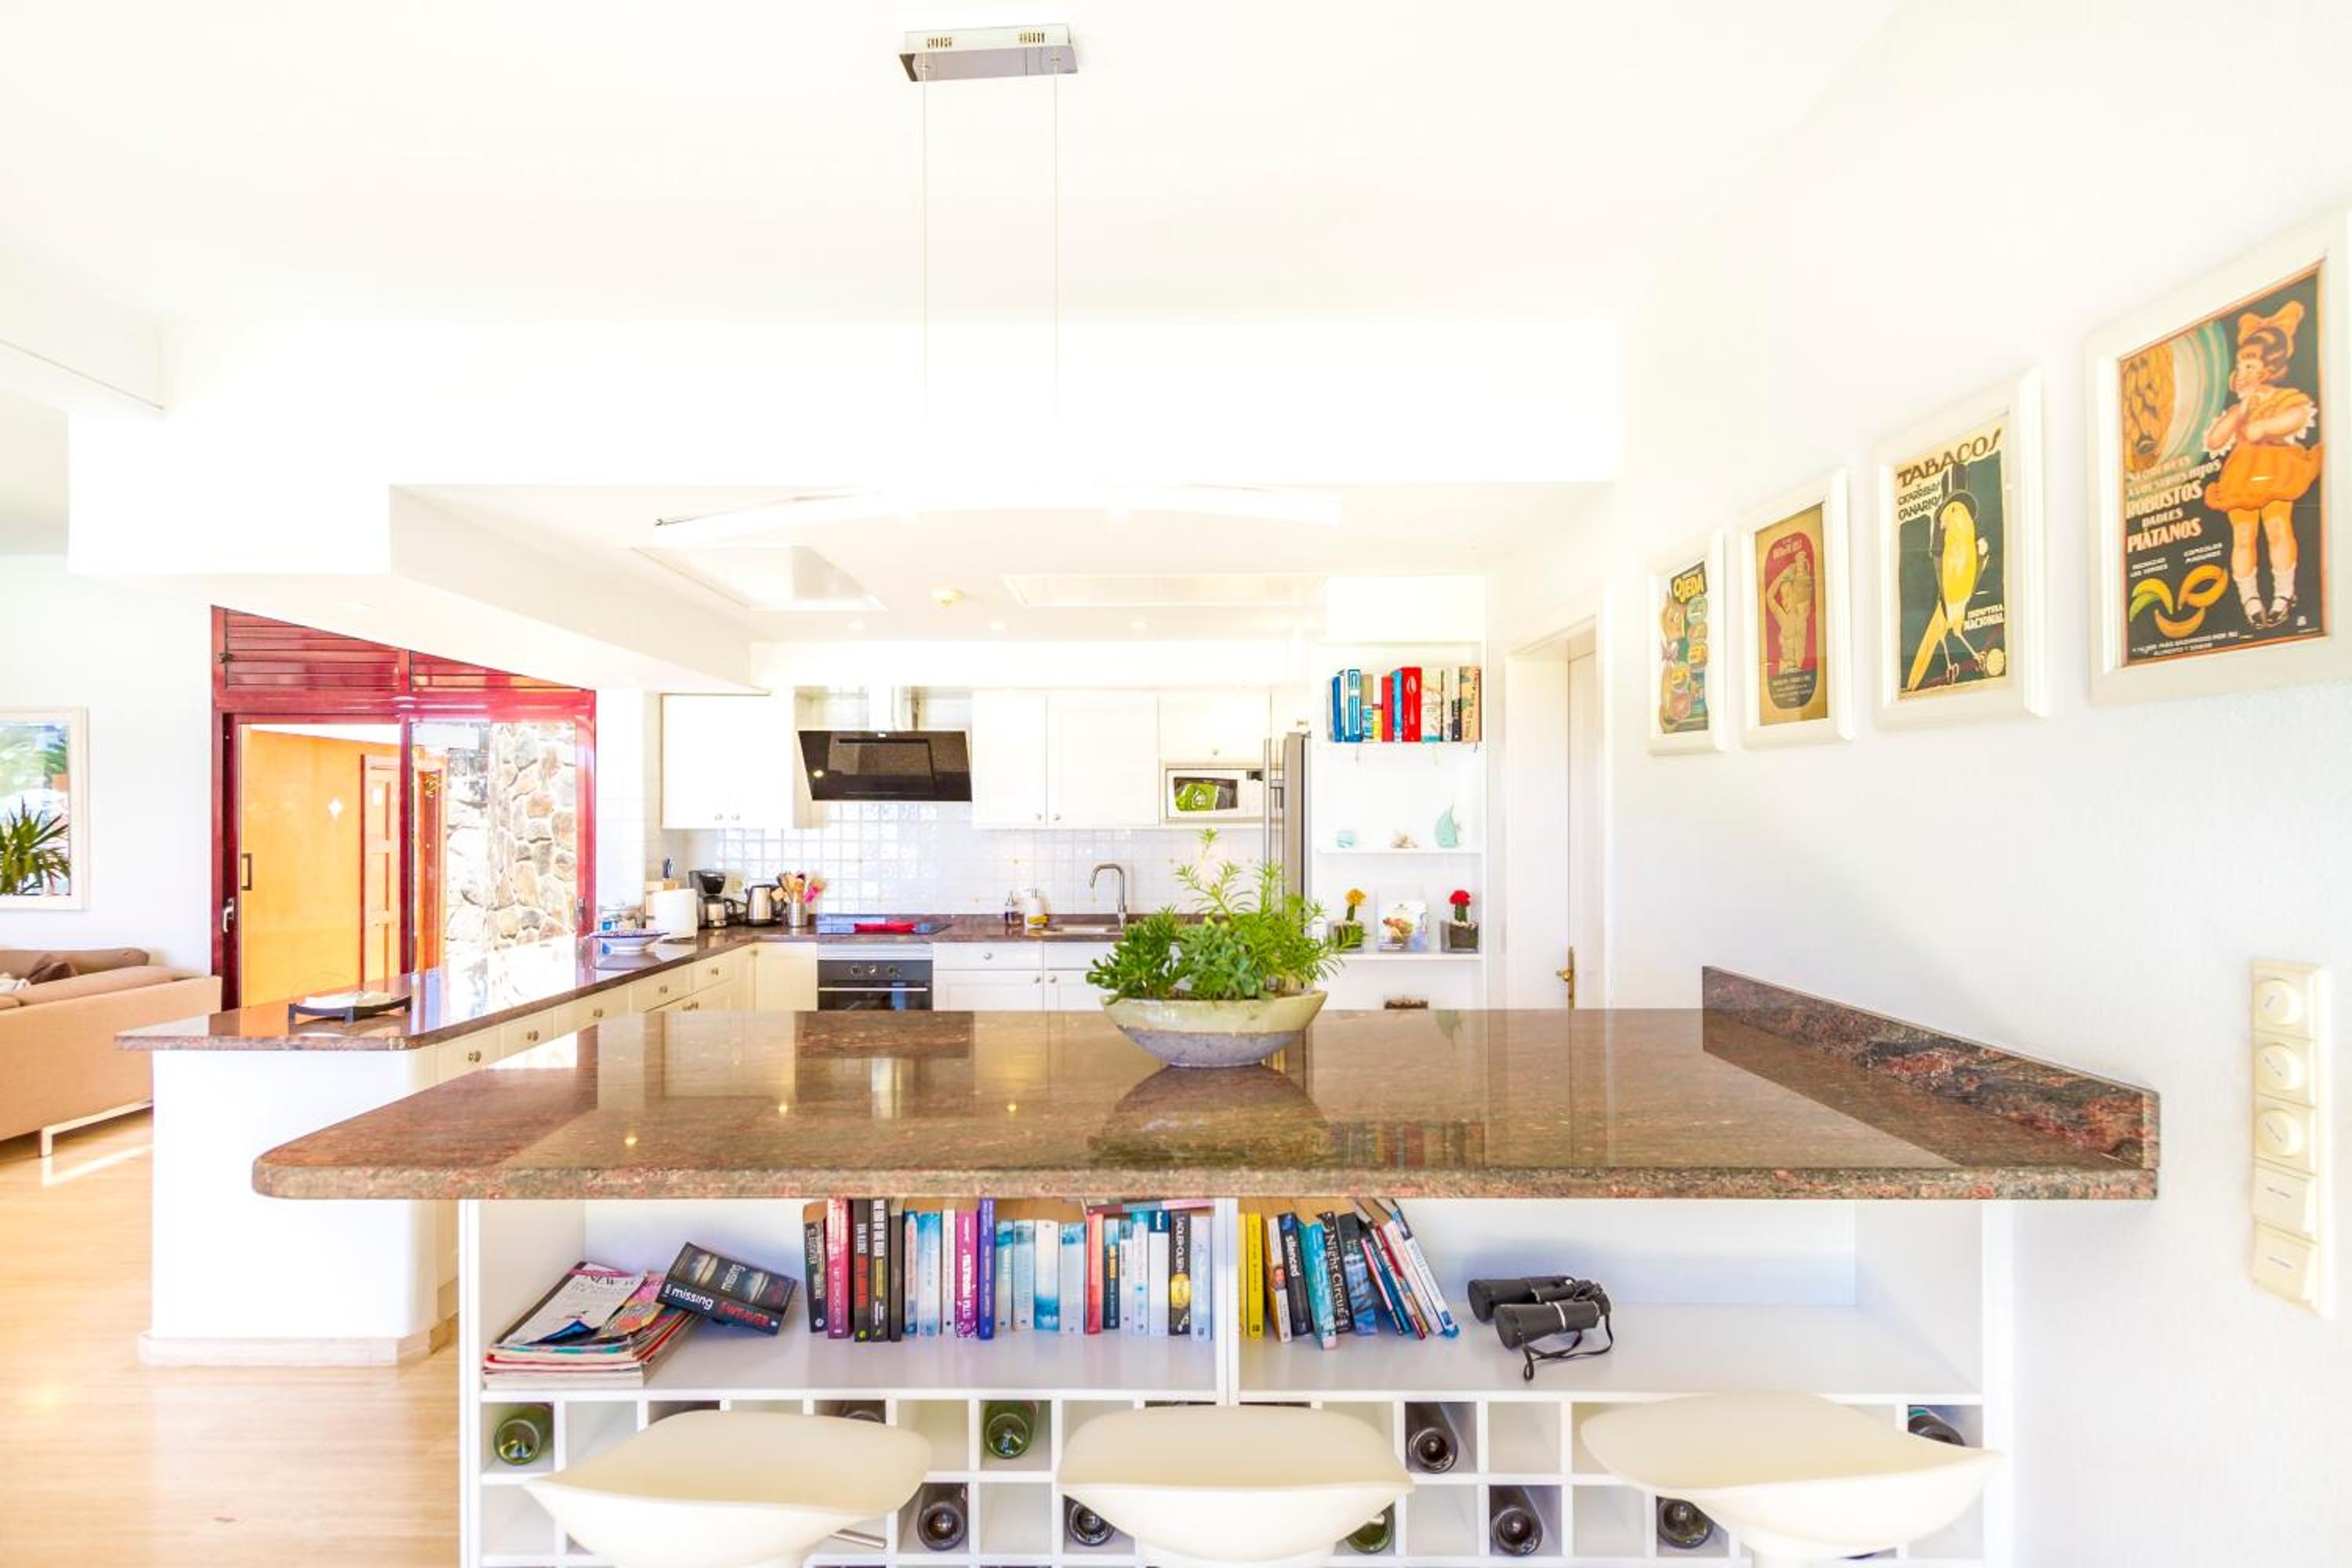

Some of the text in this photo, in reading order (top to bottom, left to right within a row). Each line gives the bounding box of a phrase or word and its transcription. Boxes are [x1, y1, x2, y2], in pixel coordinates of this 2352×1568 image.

[1896, 428, 2002, 487] TABACOS
[2125, 480, 2203, 519] ROBUSTOS
[2142, 507, 2183, 528] DADLES
[1284, 1234, 1301, 1278] silenced
[1325, 1234, 1345, 1313] Night Circus
[671, 1286, 714, 1311] missing
